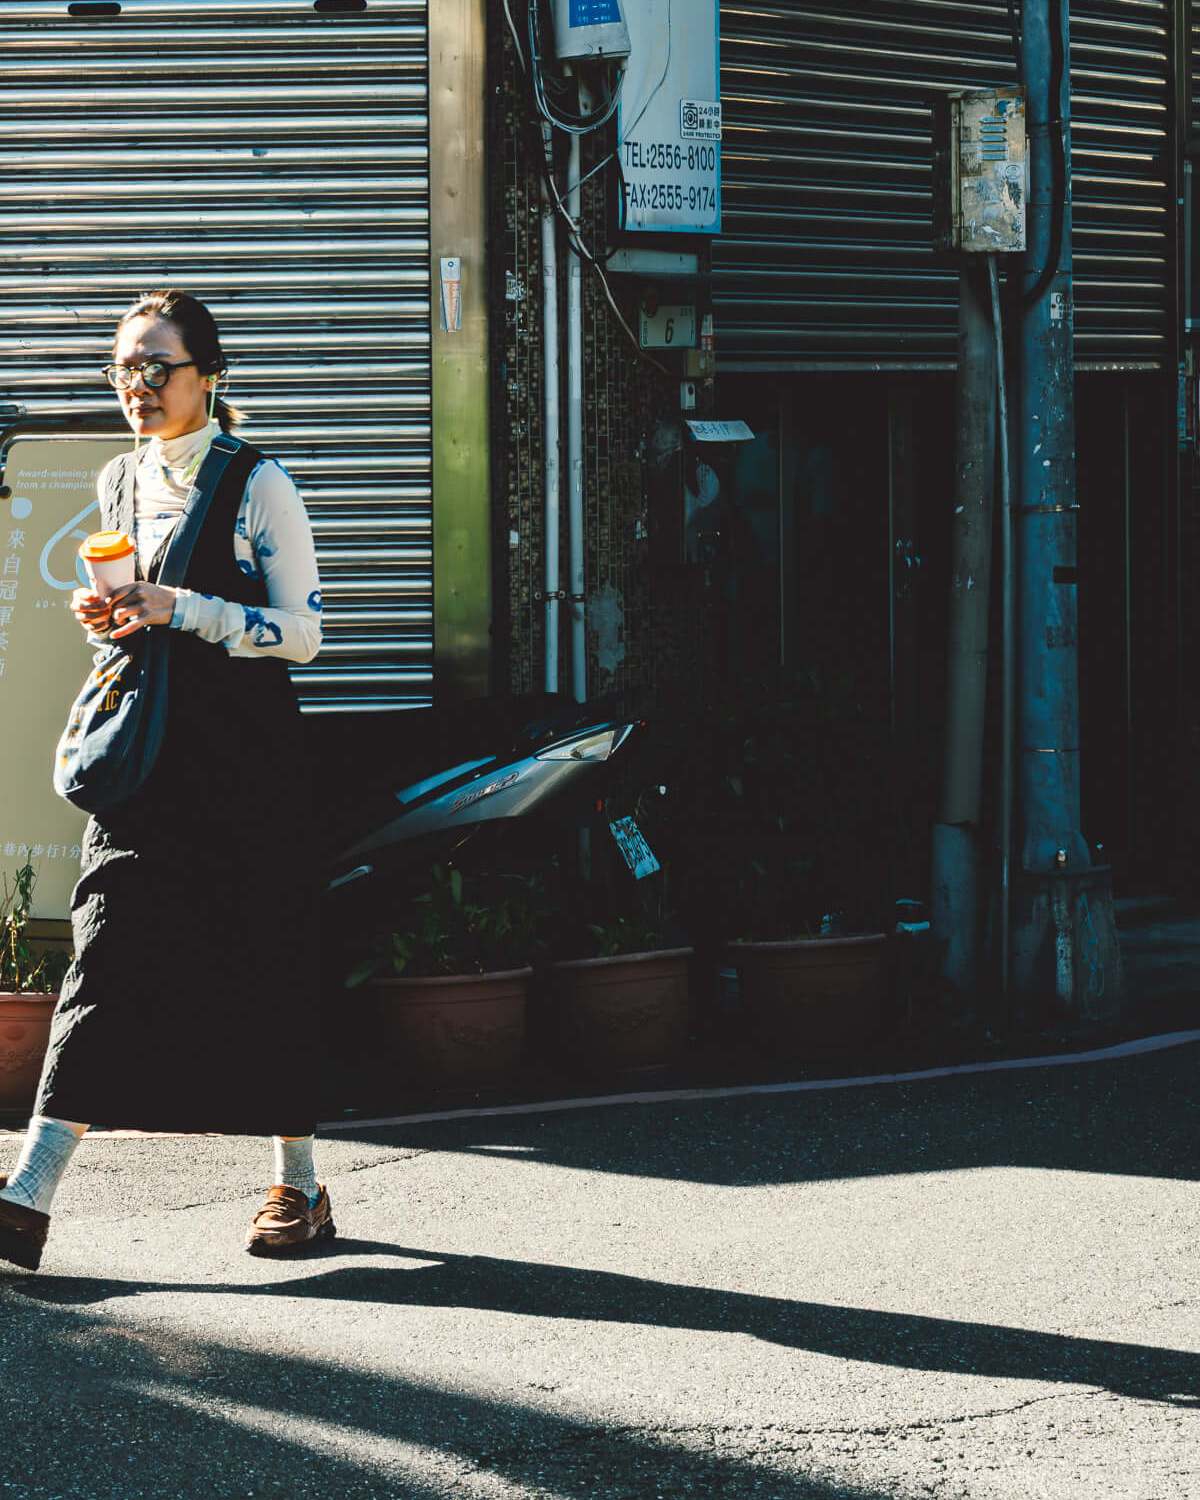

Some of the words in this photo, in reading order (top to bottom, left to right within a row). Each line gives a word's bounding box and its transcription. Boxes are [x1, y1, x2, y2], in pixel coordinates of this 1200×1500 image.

[623, 141, 715, 171] TEL:2556-8100
[624, 182, 716, 211] FAX:2555-9174
[17, 468, 88, 480] Award-winning
[16, 480, 38, 490] from
[48, 481, 94, 491] champion
